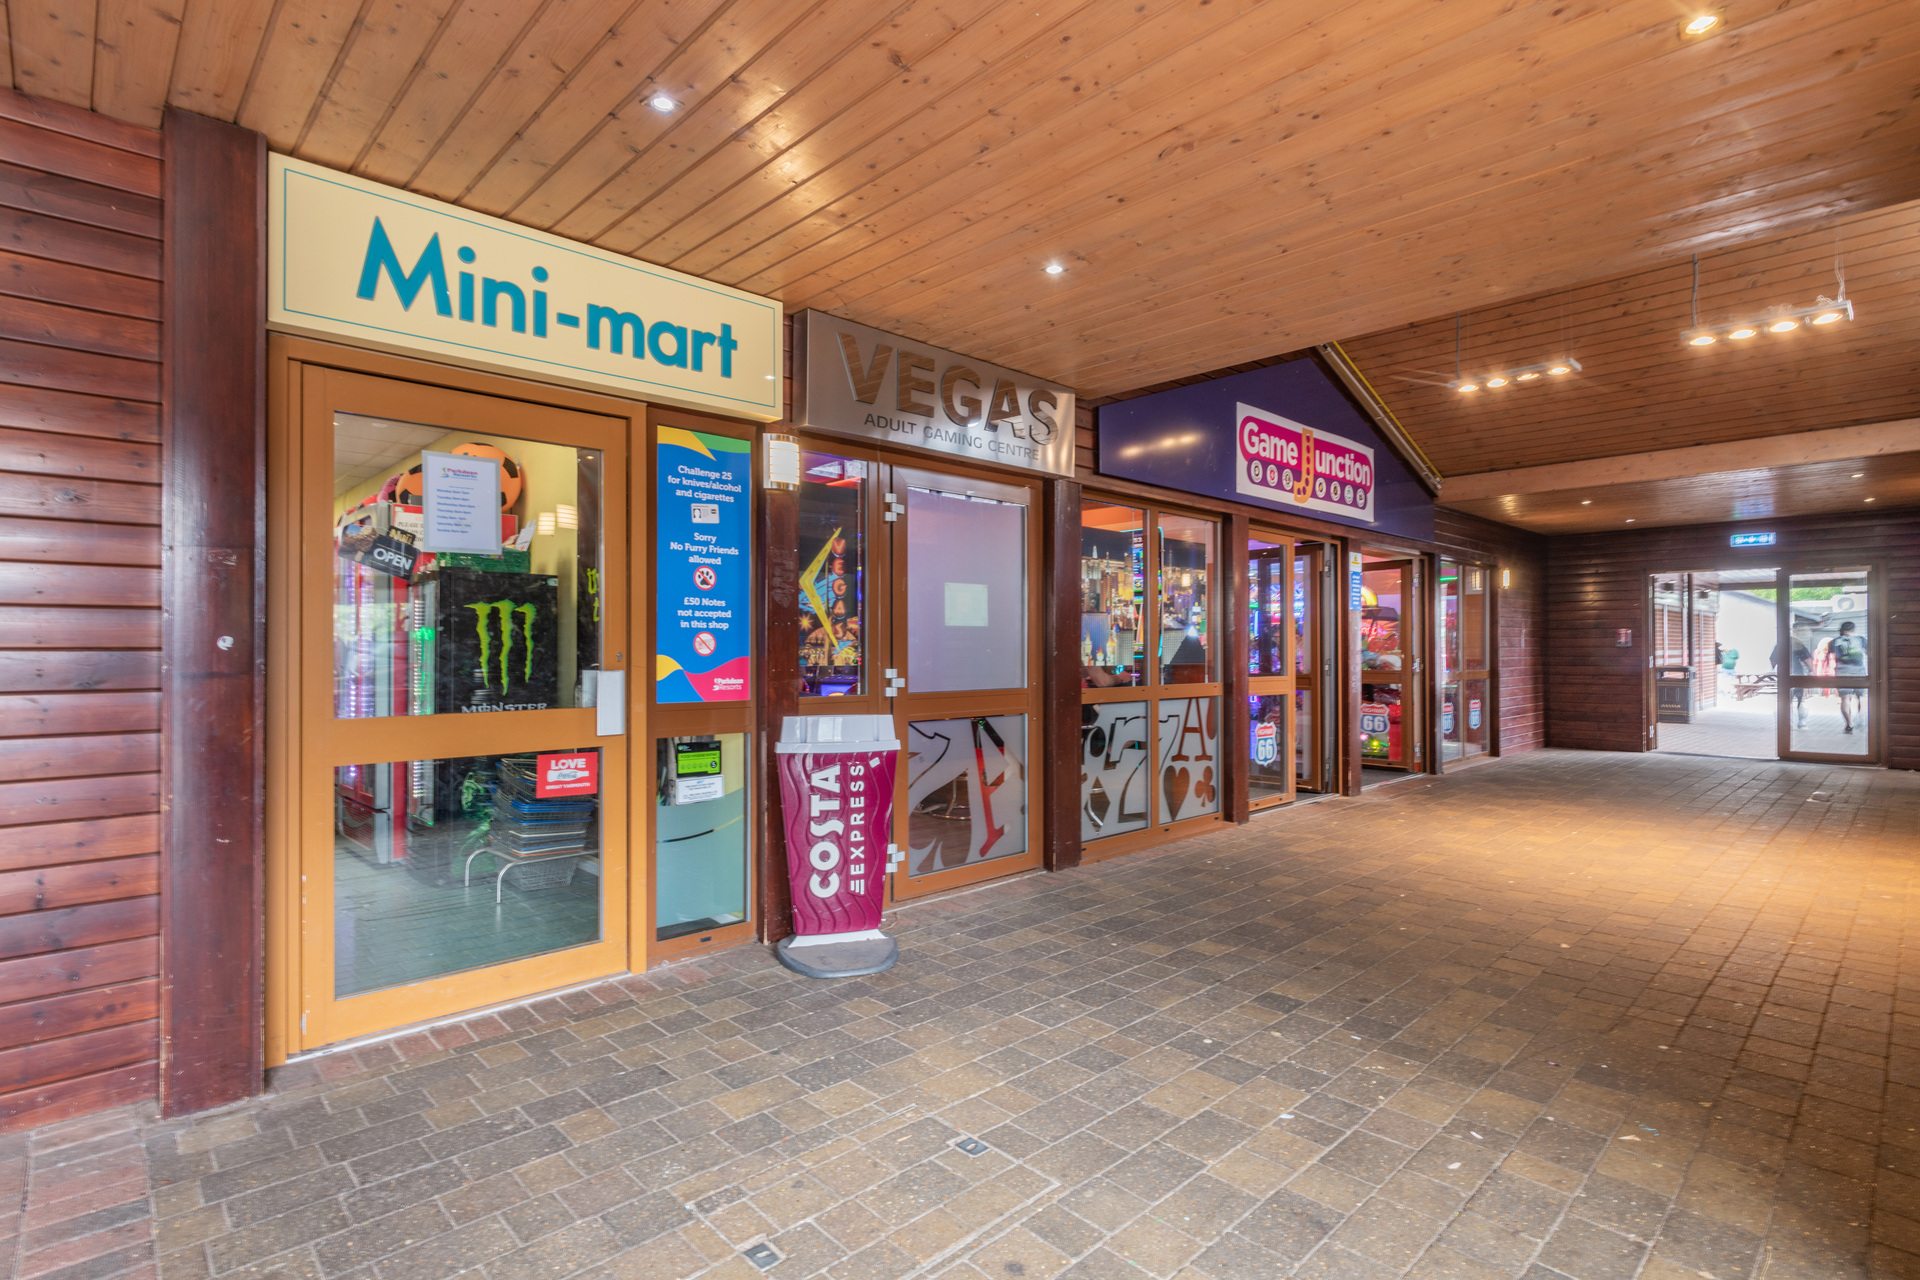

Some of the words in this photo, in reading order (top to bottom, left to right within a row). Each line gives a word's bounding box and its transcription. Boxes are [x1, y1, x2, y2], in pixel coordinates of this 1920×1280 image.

[357, 216, 737, 378] Mini-mart
[836, 331, 1059, 446] VEGAS
[864, 413, 917, 435] ADULT
[923, 425, 983, 449] GAMING
[988, 440, 1040, 461] CENTRE
[1243, 421, 1298, 466] Game
[1293, 427, 1370, 504] Junction
[678, 465, 720, 480] Challenge
[721, 471, 732, 480] 25
[667, 475, 681, 484] for
[682, 477, 742, 493] knives/alcohol
[675, 489, 693, 497] and
[694, 490, 734, 503] cigarettes
[693, 532, 717, 544] Sorry
[670, 542, 683, 551] No
[684, 543, 708, 554] Furry
[708, 545, 739, 555] Friends
[373, 548, 412, 570] OPEN
[688, 555, 722, 565] allowed
[683, 597, 700, 606] £50
[701, 598, 726, 607] Notes
[694, 610, 732, 619] accepted
[680, 620, 689, 628] in
[691, 620, 707, 628] this
[708, 621, 729, 630] shop
[1363, 715, 1385, 732] 66
[1258, 738, 1274, 761] 66
[550, 758, 586, 770] LOVE
[850, 765, 865, 876] EXPRESS
[809, 764, 845, 899] COSTA
